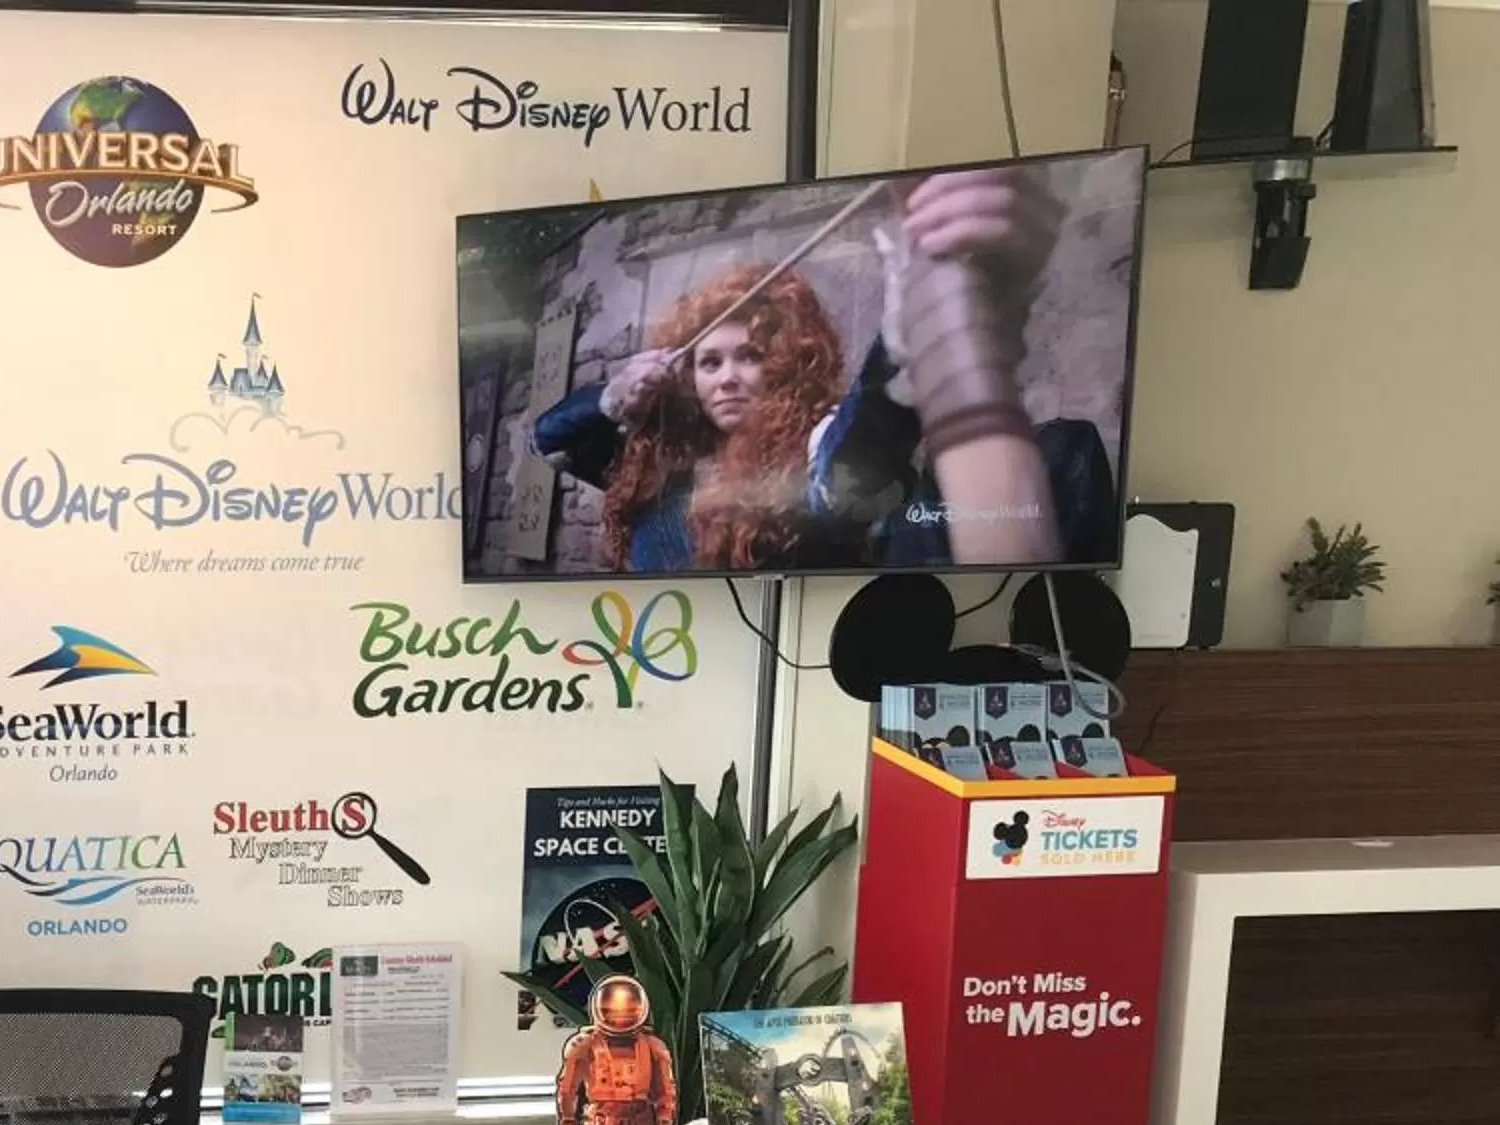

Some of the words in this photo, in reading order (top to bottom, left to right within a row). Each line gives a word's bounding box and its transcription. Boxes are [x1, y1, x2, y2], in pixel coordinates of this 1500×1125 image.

[341, 57, 438, 132] Walt
[447, 67, 611, 147] Disney
[612, 85, 751, 132] World
[45, 178, 194, 228] Orlando
[112, 223, 177, 236] RESORT
[2, 449, 130, 532] Walt
[121, 453, 338, 547] Disney
[124, 549, 192, 574] Where
[197, 549, 265, 572] dreams
[271, 556, 320, 572] come
[324, 553, 366, 572] true
[349, 599, 558, 662] Busch
[353, 654, 591, 718] Gardens
[133, 743, 189, 755] PARK
[49, 763, 118, 782] Orlando
[560, 808, 657, 829] KENNEDY
[1041, 808, 1088, 831] Disney
[229, 837, 328, 864] Mystery
[534, 838, 599, 857] SPACE
[1040, 829, 1138, 851] TICKETS
[1040, 852, 1086, 866] SOLD
[1092, 850, 1137, 864] HERE
[278, 863, 364, 885] Dinner
[327, 884, 404, 907] Shows
[27, 918, 129, 936] ORLANDO
[538, 921, 631, 965] NAS
[963, 975, 1028, 998] Don't
[1033, 971, 1088, 993] Miss
[966, 1004, 1006, 1025] the
[1007, 991, 1142, 1038] Magic.
